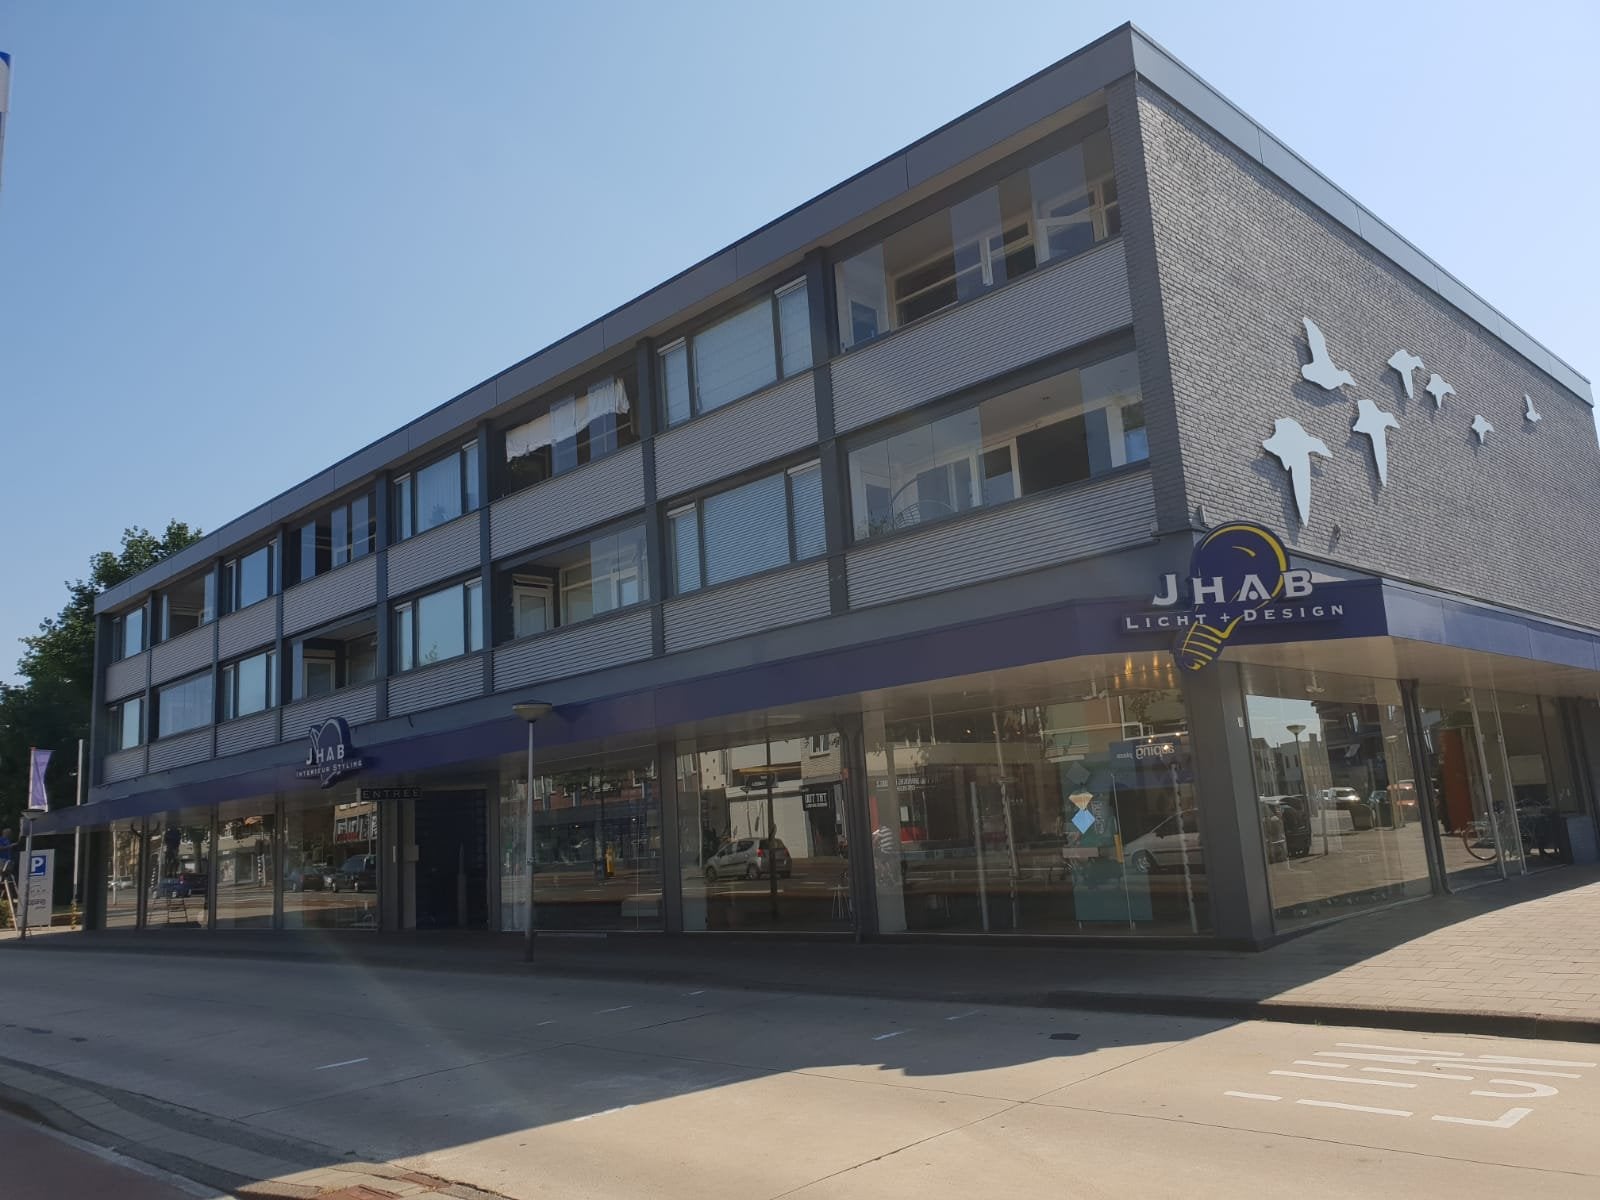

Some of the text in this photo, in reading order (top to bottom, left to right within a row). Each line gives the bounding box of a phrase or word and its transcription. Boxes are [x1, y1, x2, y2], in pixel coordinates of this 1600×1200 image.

[1152, 569, 1314, 606] JHAB
[1125, 613, 1208, 630] LICHT
[1243, 604, 1344, 622] DESIGN
[306, 744, 345, 765] JHAB
[363, 788, 420, 799] ENTREE
[31, 857, 44, 873] P
